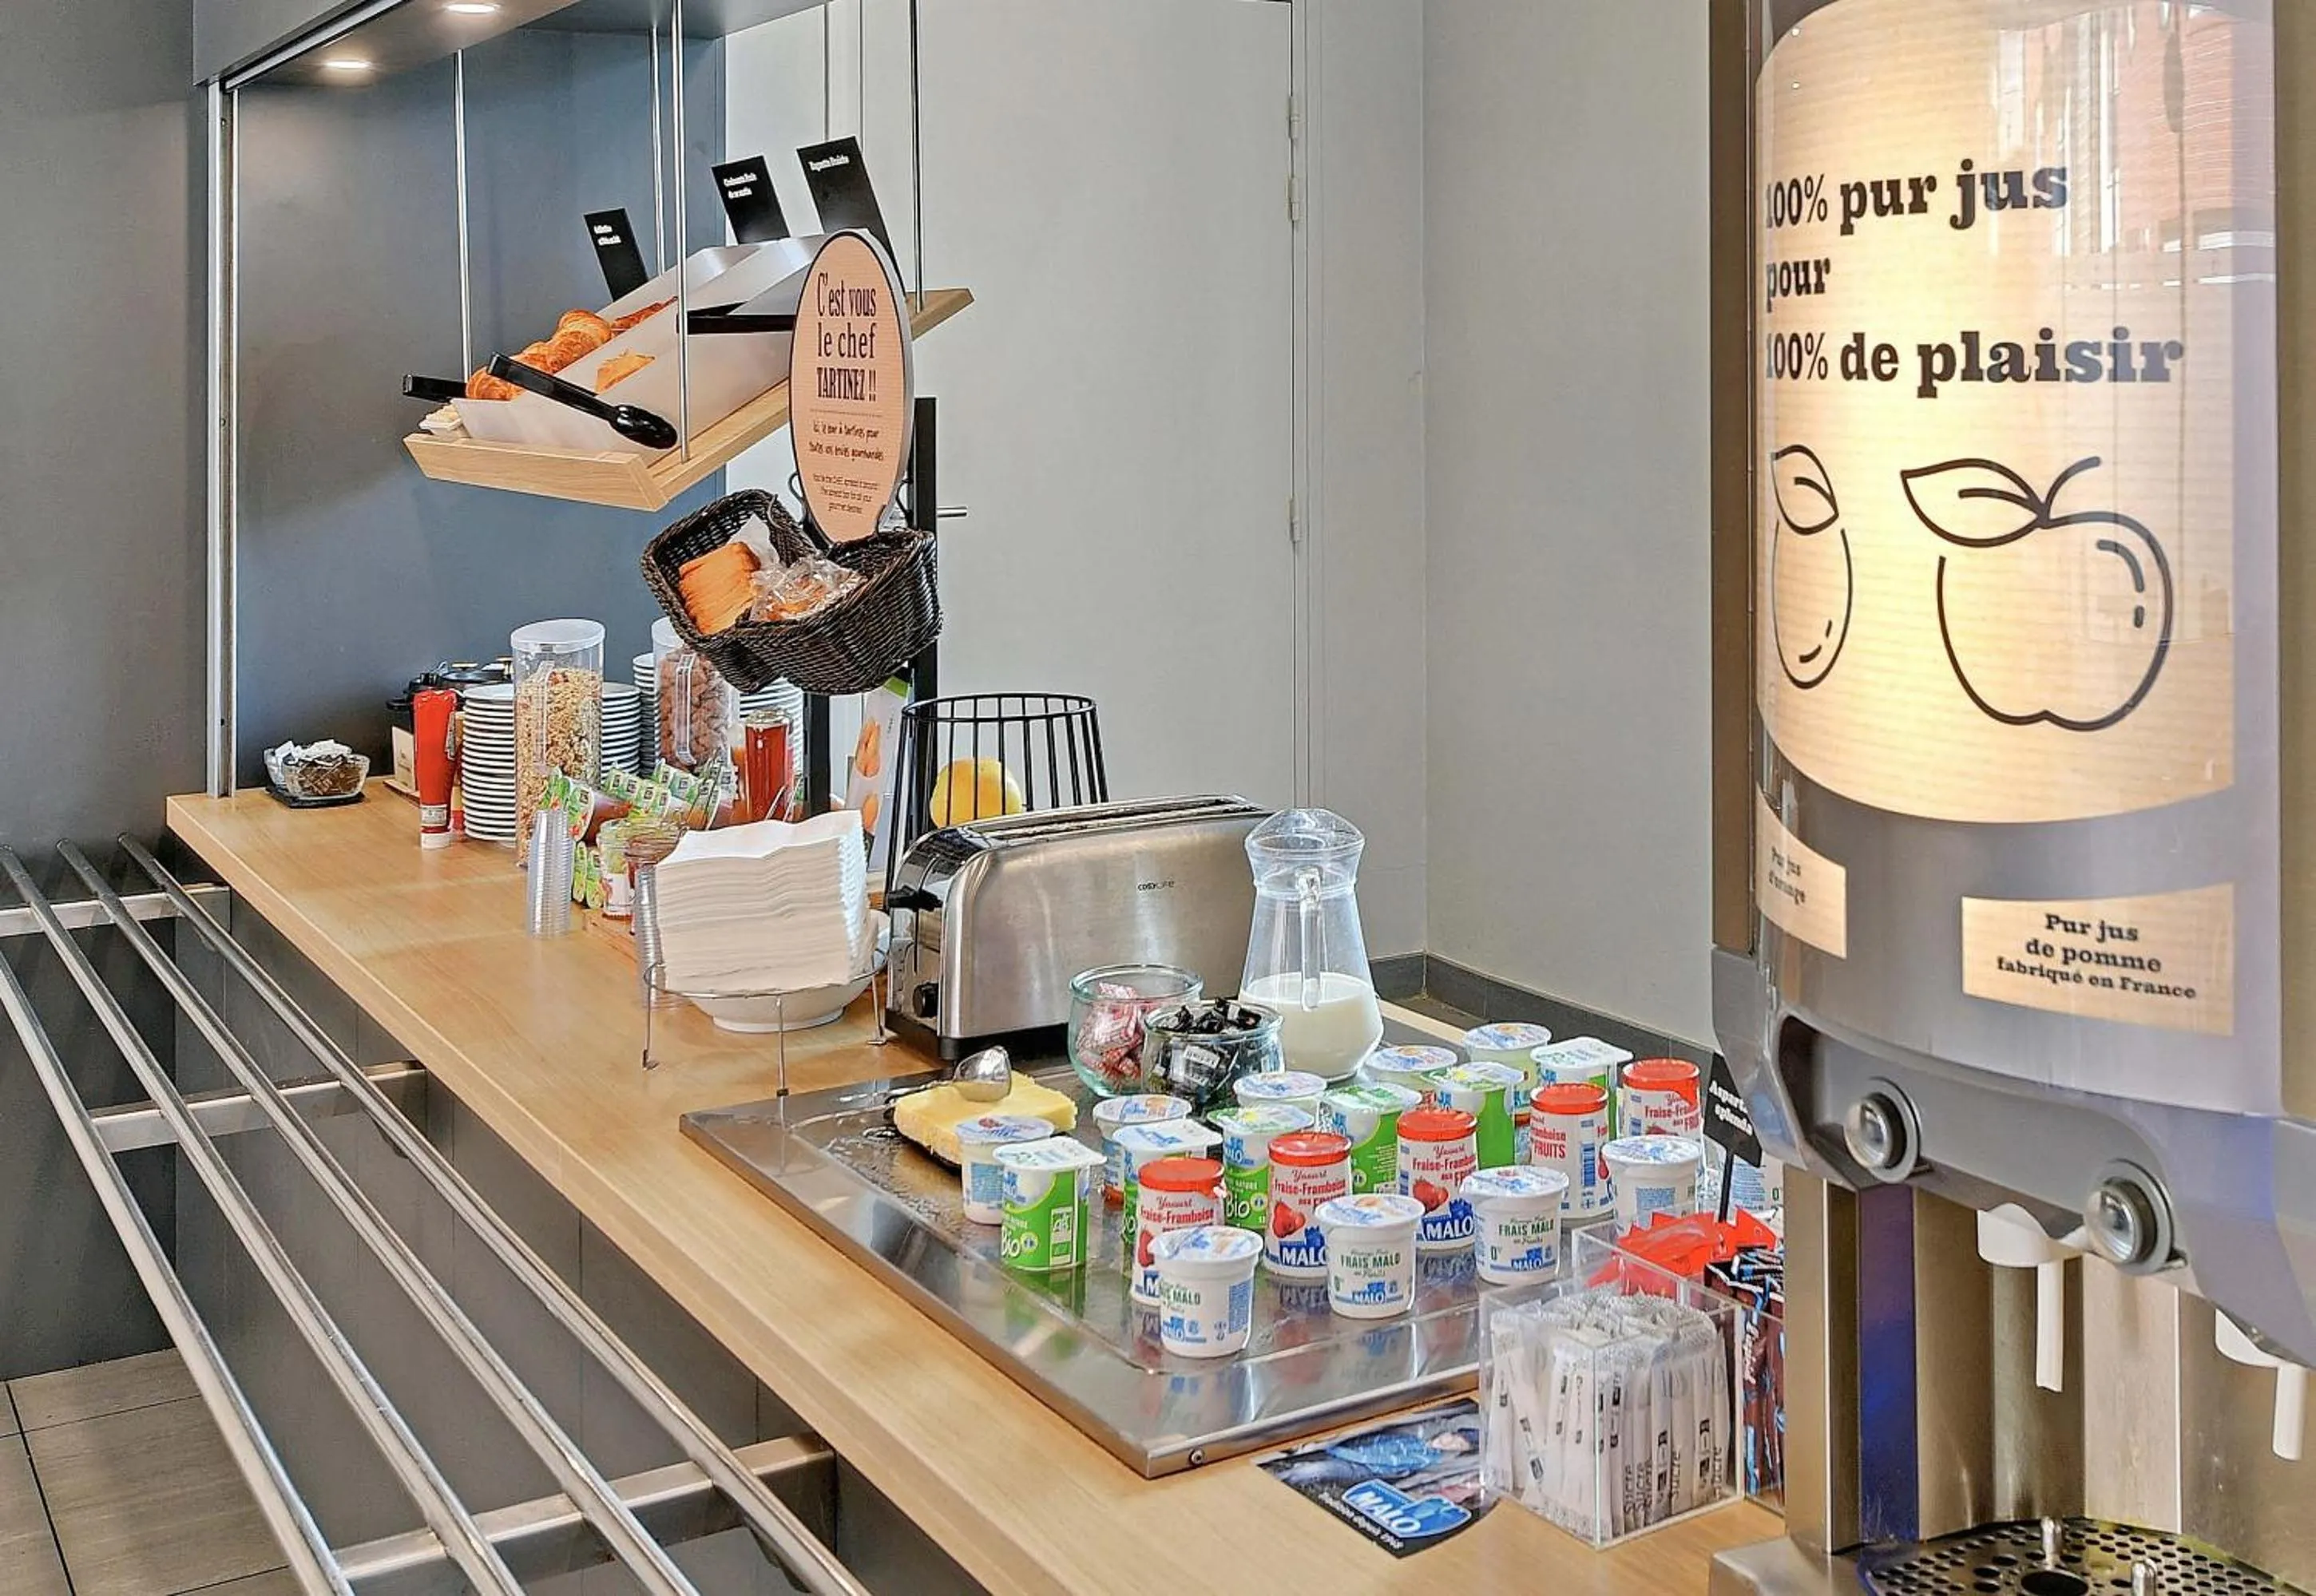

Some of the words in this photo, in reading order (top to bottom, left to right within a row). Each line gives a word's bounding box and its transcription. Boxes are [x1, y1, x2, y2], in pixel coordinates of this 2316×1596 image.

[1766, 173, 1828, 228] 100%
[1840, 172, 1937, 236] pur
[1949, 158, 2068, 230] jus
[817, 272, 845, 317] C'est
[849, 287, 876, 317] vous
[1766, 257, 1830, 314] pour
[818, 322, 832, 357] le
[839, 322, 877, 358] chef
[1766, 331, 1829, 381] 100%
[1840, 332, 1899, 382] de
[1917, 326, 2184, 398] plaisir
[817, 367, 865, 401] TARTINEZ
[1786, 854, 1802, 877] jus
[2044, 913, 2091, 936] Pur
[2096, 919, 2140, 943] jus
[2025, 938, 2055, 957] de
[2061, 946, 2162, 972] pomme
[1997, 956, 2084, 984] fabriqué
[2088, 975, 2115, 989] en
[2119, 976, 2197, 1000] France
[1534, 1141, 1566, 1158] FRUITS
[1426, 1216, 1474, 1239] MALO
[1499, 1224, 1528, 1237] FRAIS
[1341, 1254, 1369, 1269] FRAIS
[1373, 1252, 1401, 1267] MALO
[1173, 1289, 1200, 1305] MALO
[1353, 1491, 1421, 1533] MALO
